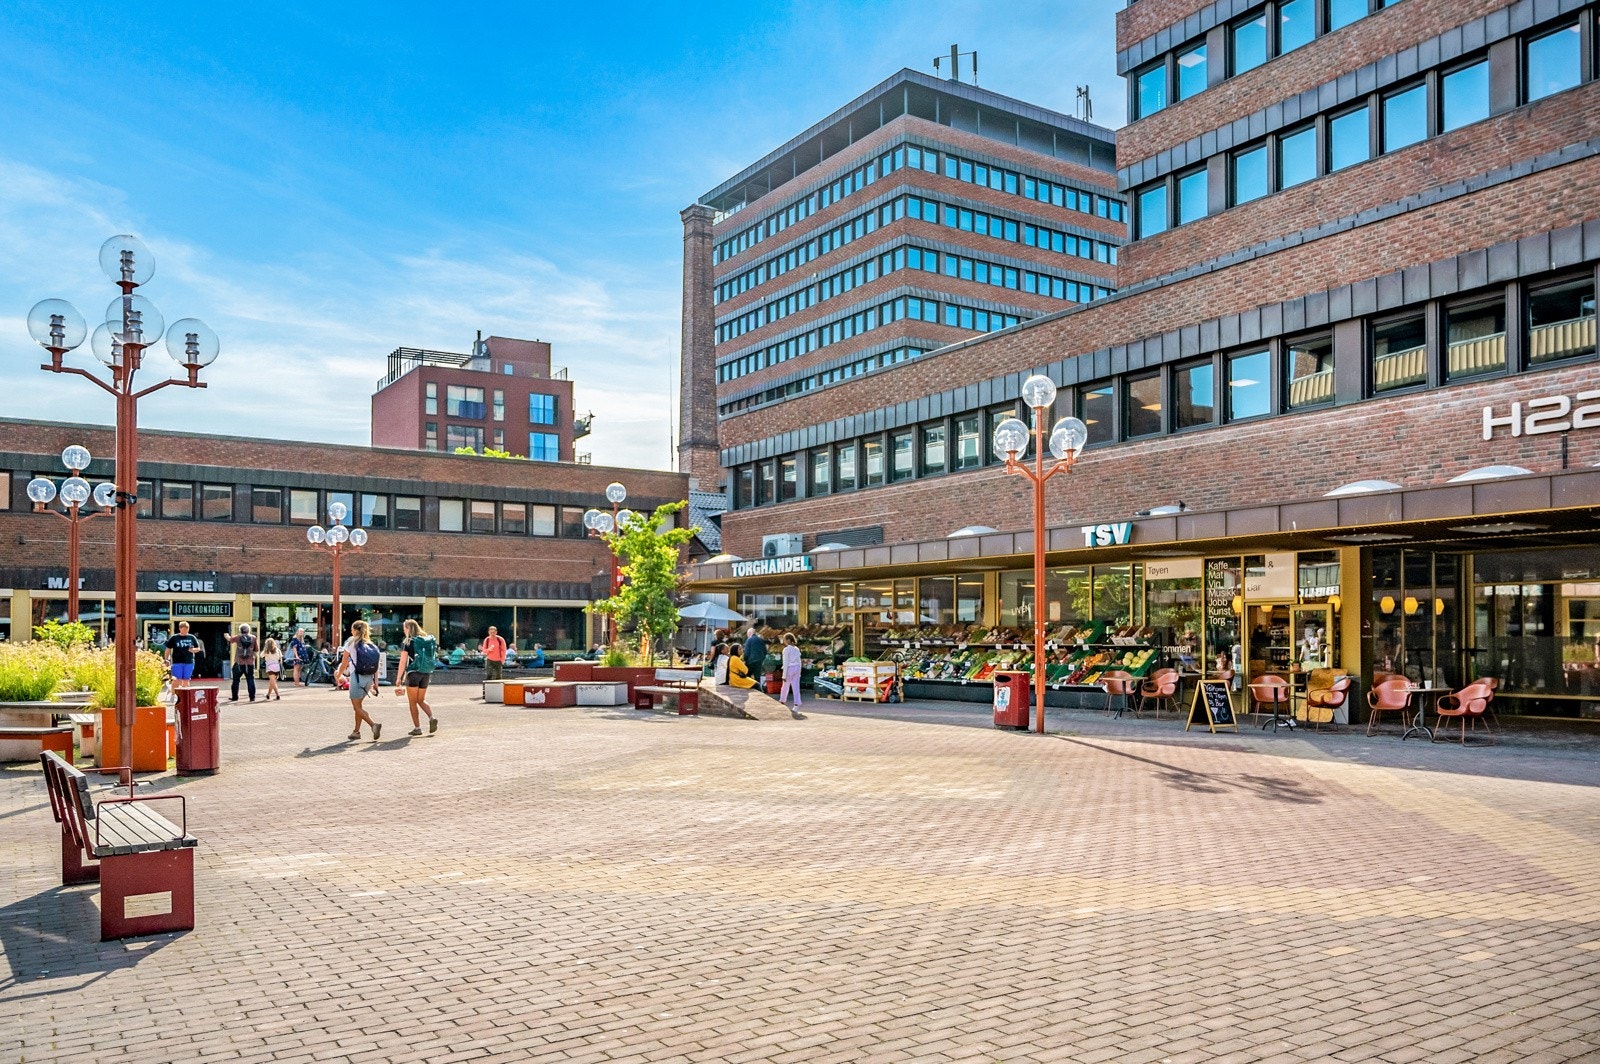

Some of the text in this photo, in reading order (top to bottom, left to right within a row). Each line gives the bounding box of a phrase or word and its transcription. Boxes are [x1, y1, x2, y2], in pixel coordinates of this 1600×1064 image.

[1081, 521, 1132, 547] TSV
[731, 555, 812, 577] TORGHANDEL
[1208, 561, 1229, 570] Kaffe
[1148, 567, 1169, 576] Tøyen
[1208, 571, 1225, 579] Mat
[157, 579, 214, 592] SCENE
[1208, 580, 1221, 588] Vin
[1208, 589, 1236, 597] Musikk
[1208, 598, 1228, 606] Jobb
[178, 605, 228, 614] POSTKONTORET
[1208, 607, 1231, 616] Kunst
[1208, 616, 1226, 627] Torg
[1154, 644, 1191, 653] ommen
